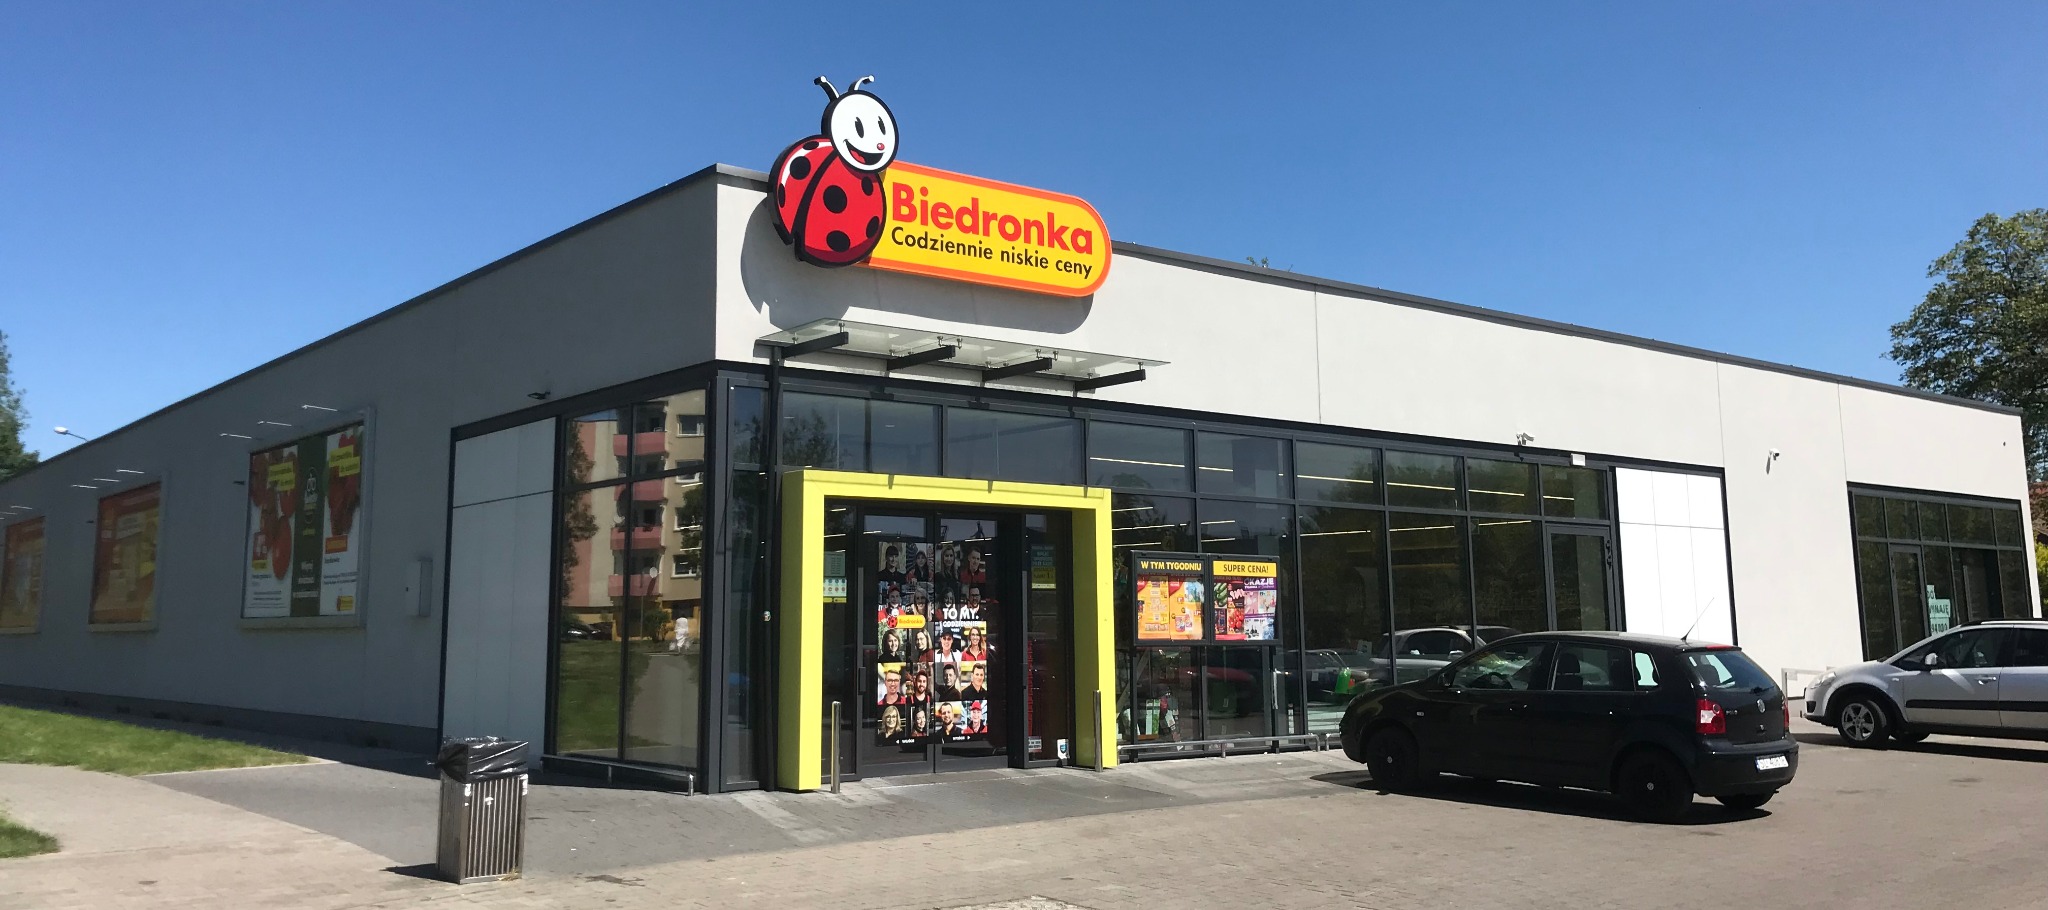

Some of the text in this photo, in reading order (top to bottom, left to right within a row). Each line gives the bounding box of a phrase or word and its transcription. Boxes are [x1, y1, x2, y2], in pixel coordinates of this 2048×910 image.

[892, 182, 1093, 255] Biedronka
[891, 226, 1093, 279] Codziennie niskie ceny
[1140, 560, 1202, 571] W TYM TYGODNIU
[1223, 564, 1269, 573] SUPER CENA!
[1244, 577, 1274, 586] OKAZJE
[942, 607, 980, 620] TO MY.
